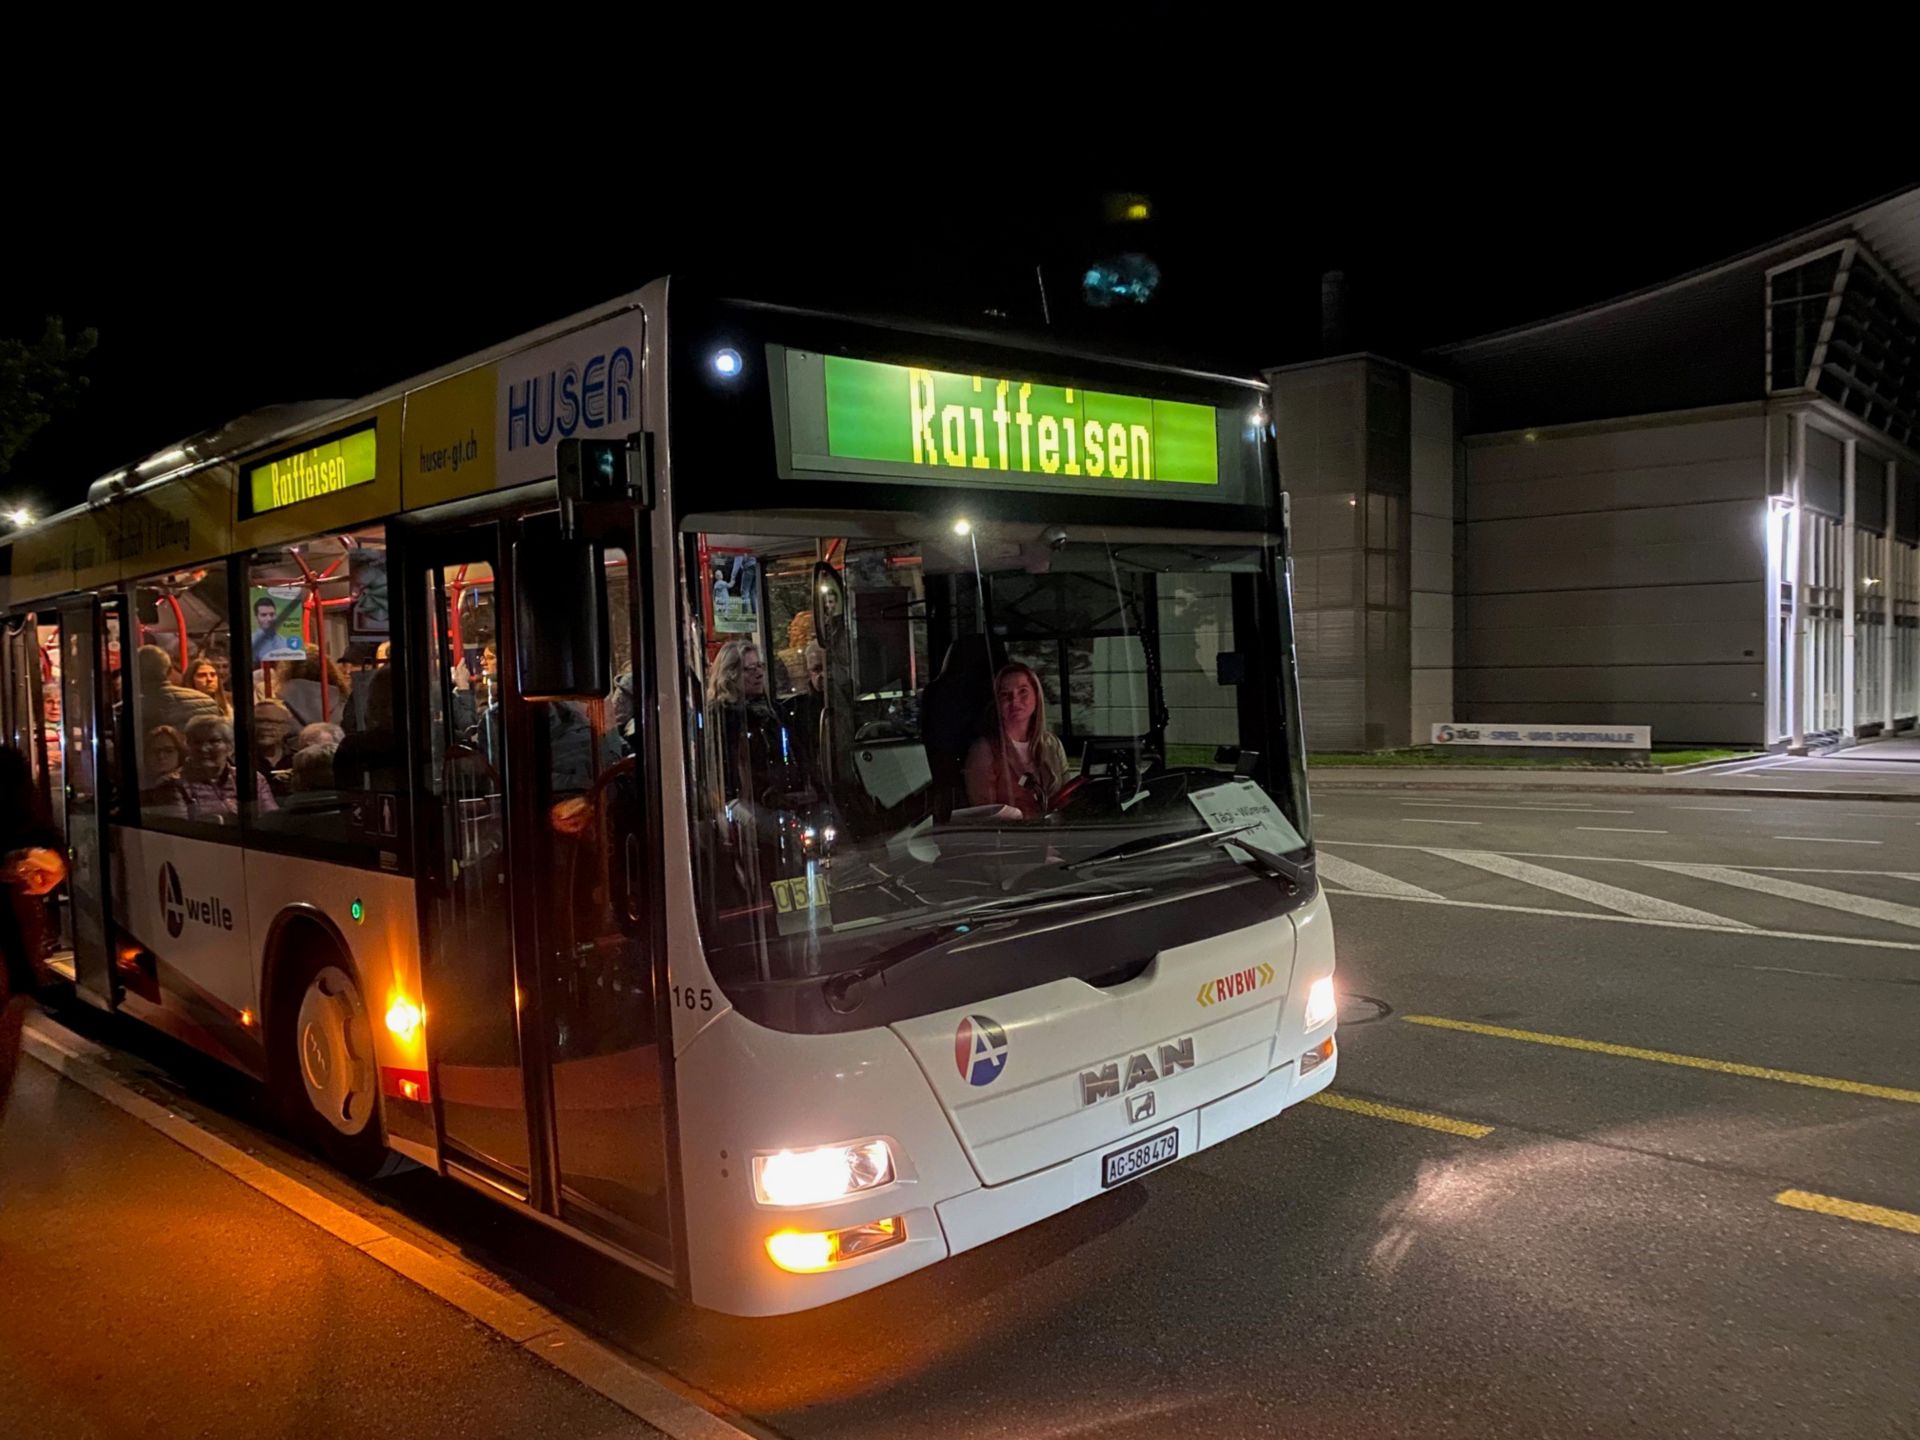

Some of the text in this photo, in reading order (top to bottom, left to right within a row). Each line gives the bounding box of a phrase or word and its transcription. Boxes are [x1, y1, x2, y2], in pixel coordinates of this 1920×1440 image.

[508, 347, 633, 451] HUSER
[909, 367, 1151, 480] Raiffeisen
[271, 447, 346, 508] Raiffeisen
[185, 896, 233, 931] welle
[672, 985, 713, 1011] 165
[1216, 967, 1256, 1002] RVBW
[1080, 1036, 1195, 1106] MAN
